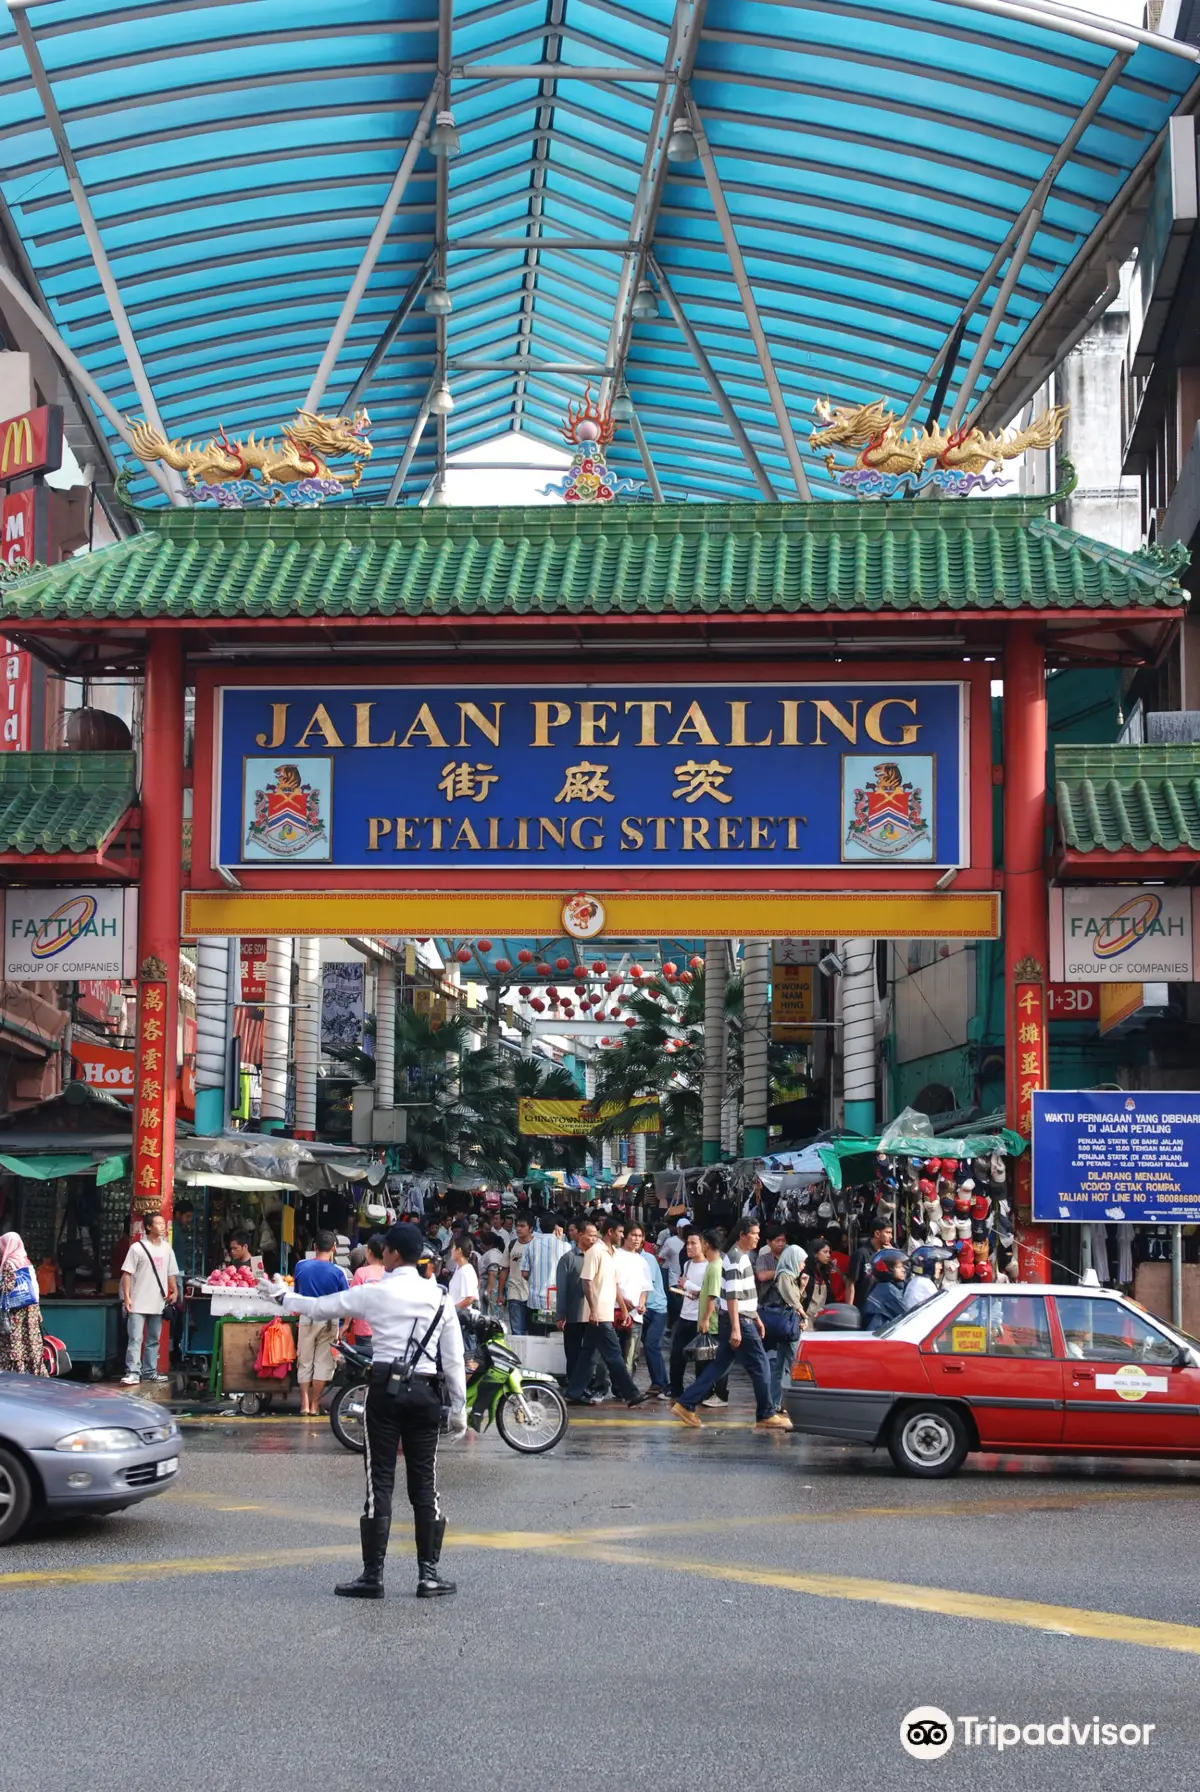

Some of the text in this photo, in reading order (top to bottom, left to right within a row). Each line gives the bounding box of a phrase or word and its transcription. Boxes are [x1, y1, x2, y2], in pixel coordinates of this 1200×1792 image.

[255, 698, 923, 748] JALAN PETALING
[366, 816, 807, 851] PETALING STREET
[12, 918, 116, 938] FATTUAH
[1070, 916, 1184, 937] FATTUAH
[8, 962, 120, 973] GROUP OF COMPANIES
[1068, 963, 1188, 973] GROUP OF COMPANIES
[524, 1114, 580, 1124] CHINATOWN
[1044, 1113, 1074, 1122] WAKTU
[1078, 1113, 1132, 1123] PERNIAGAAN
[1136, 1114, 1158, 1123] YANG
[1088, 1124, 1171, 1134] DI JALAN PETALING
[1088, 1172, 1174, 1181] DILARANG MENJUAL
[1081, 1182, 1181, 1192] VCD/CD CETAK ROMPAK
[1058, 1193, 1088, 1201] TALIAN
[1092, 1193, 1108, 1202] HOT
[1112, 1194, 1130, 1202] LINE
[1134, 1194, 1146, 1202] NO
